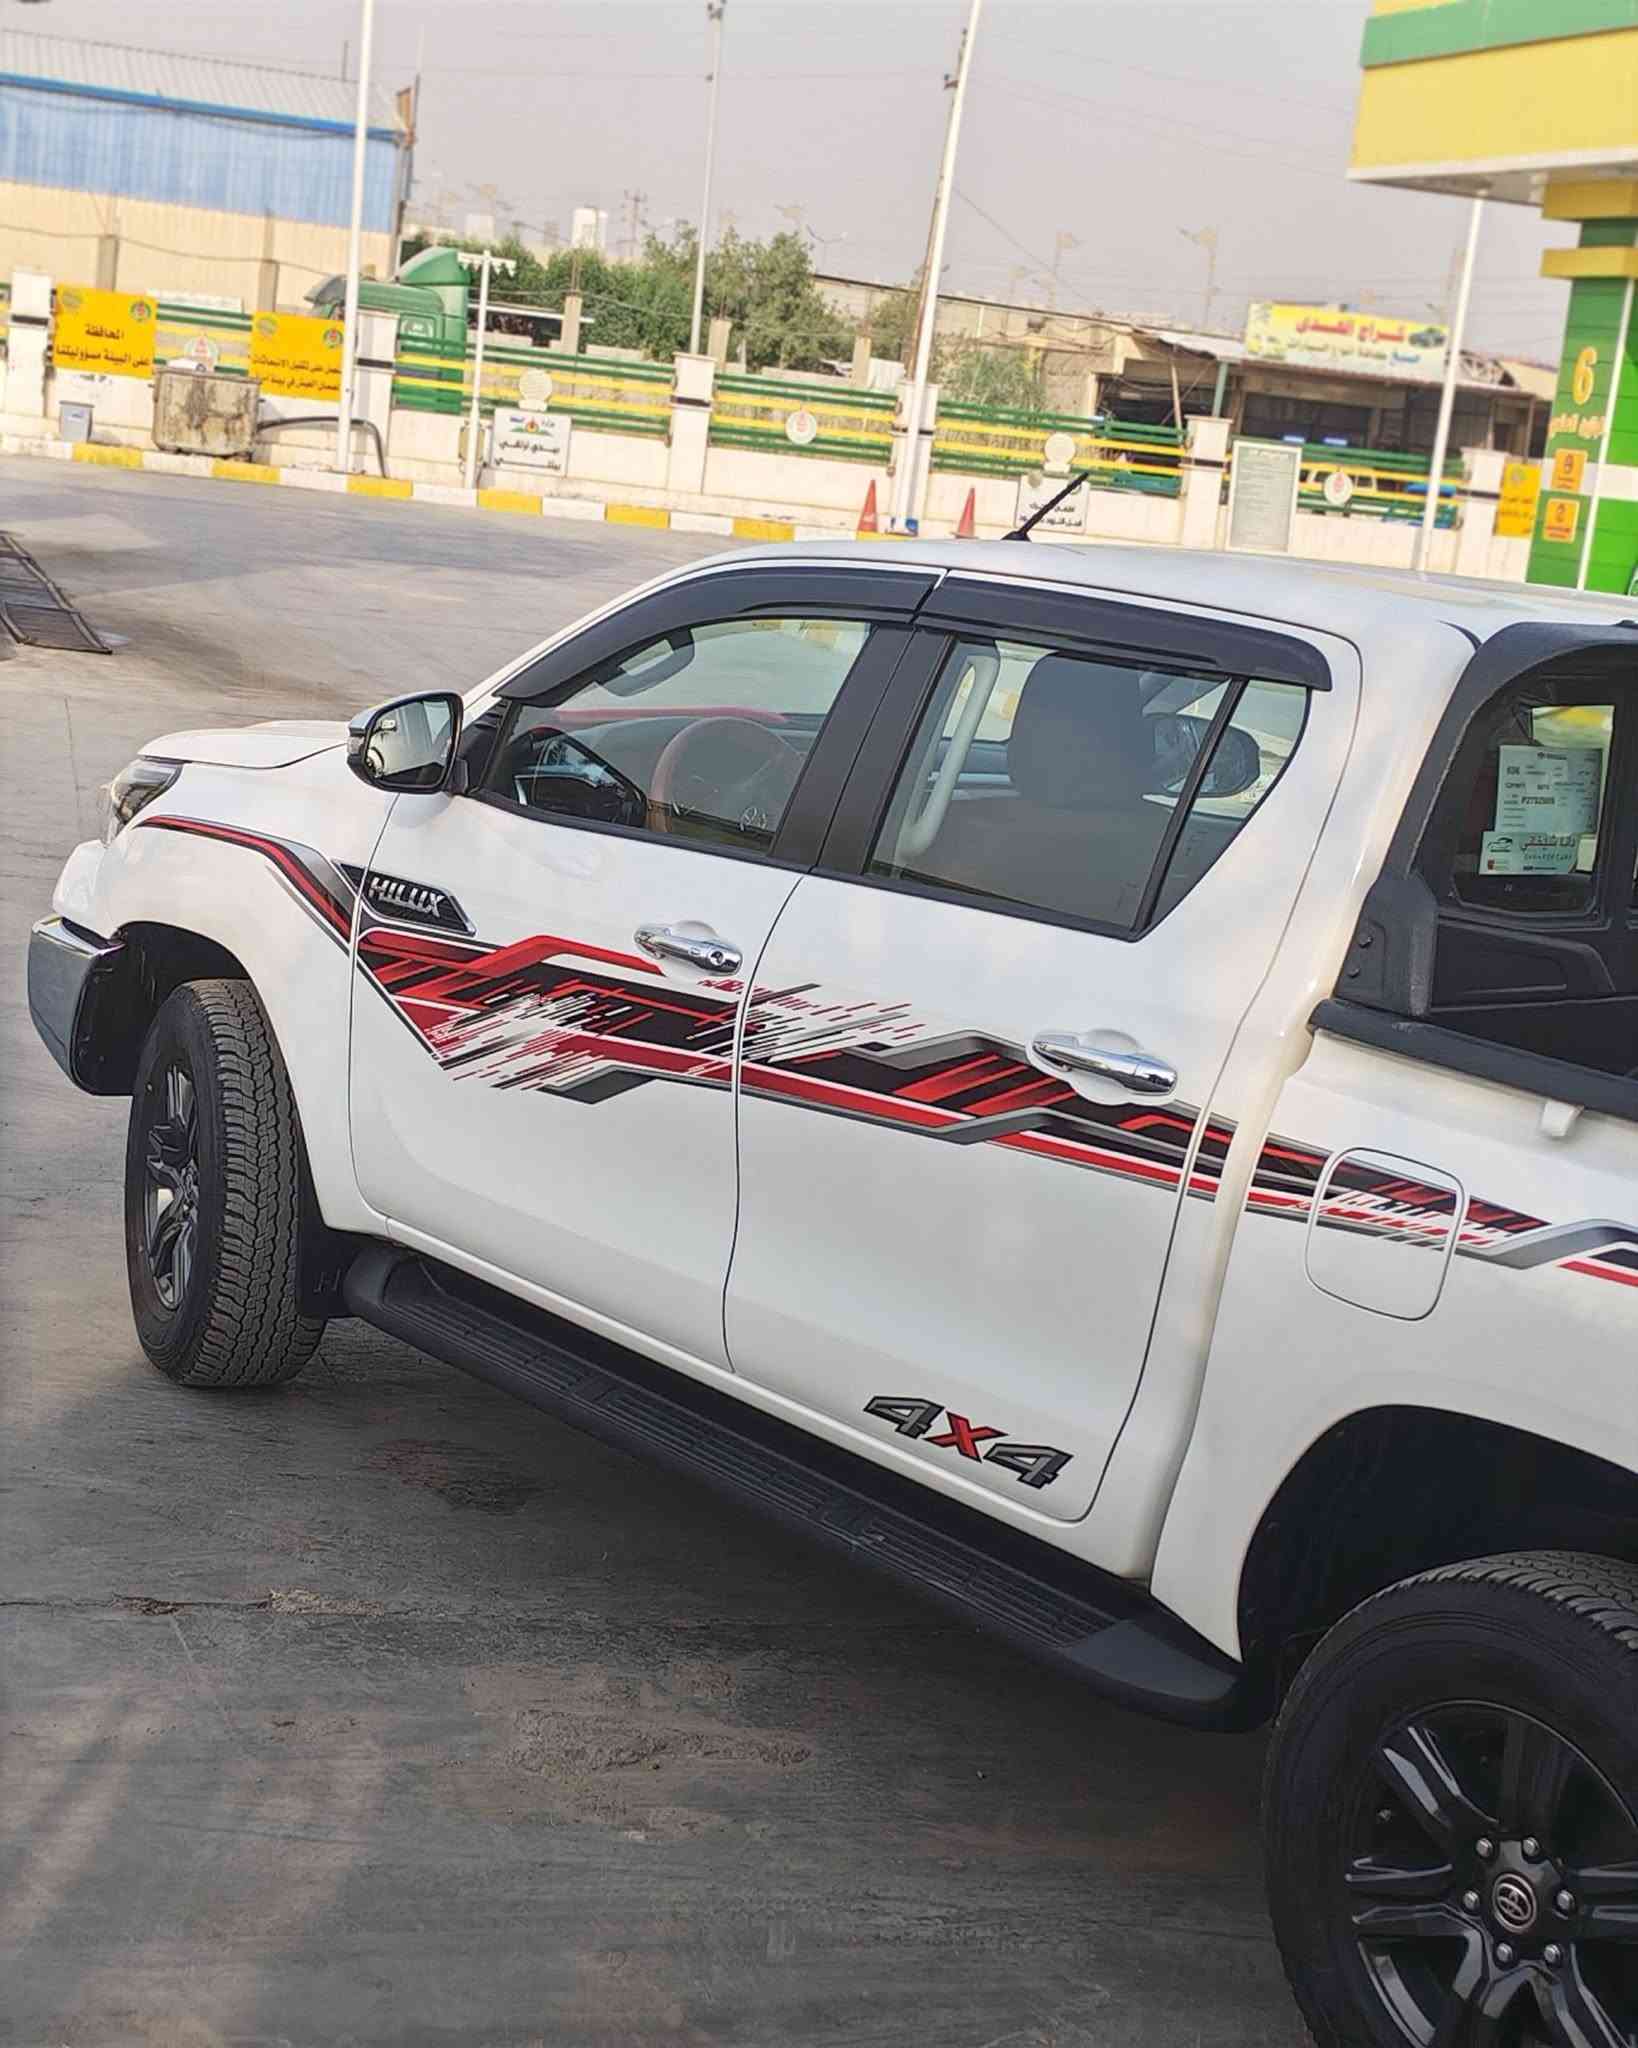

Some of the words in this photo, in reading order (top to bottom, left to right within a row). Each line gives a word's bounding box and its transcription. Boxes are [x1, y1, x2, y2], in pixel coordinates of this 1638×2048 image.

[85, 323, 124, 340] المحافظة
[104, 348, 131, 366] البيئة
[132, 356, 150, 369] على
[1573, 346, 1597, 405] 6
[368, 877, 446, 918] HILUX
